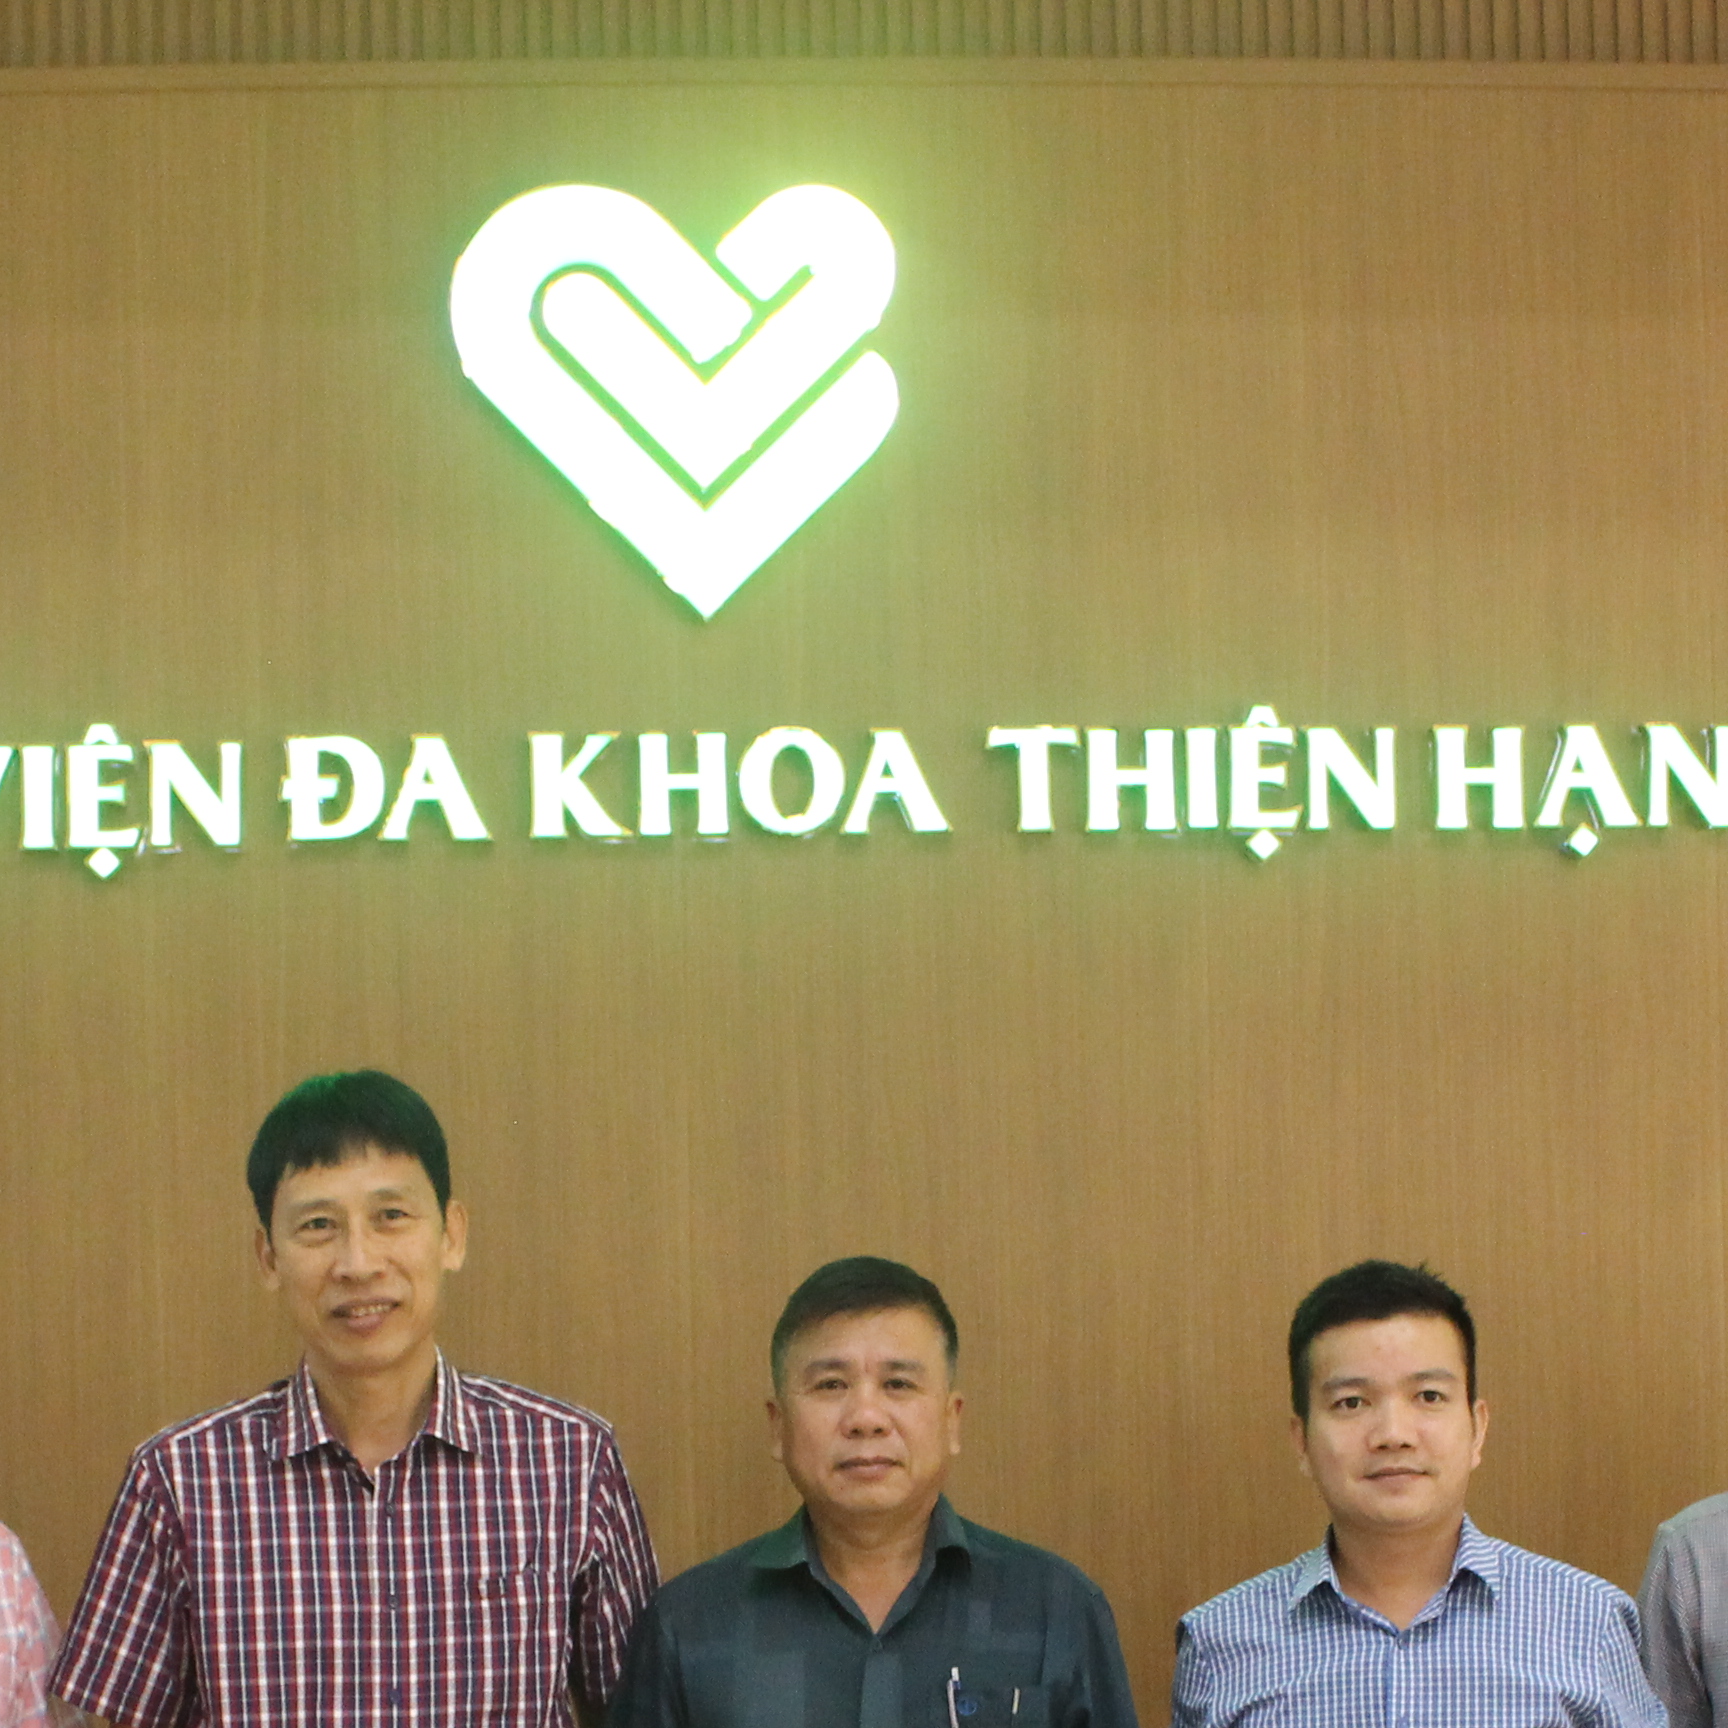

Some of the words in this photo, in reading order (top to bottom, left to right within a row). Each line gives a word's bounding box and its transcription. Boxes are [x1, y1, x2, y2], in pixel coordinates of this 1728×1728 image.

[280, 733, 492, 842] ĐA
[528, 724, 952, 839] KHOA
[985, 704, 1397, 861] THIỆN
